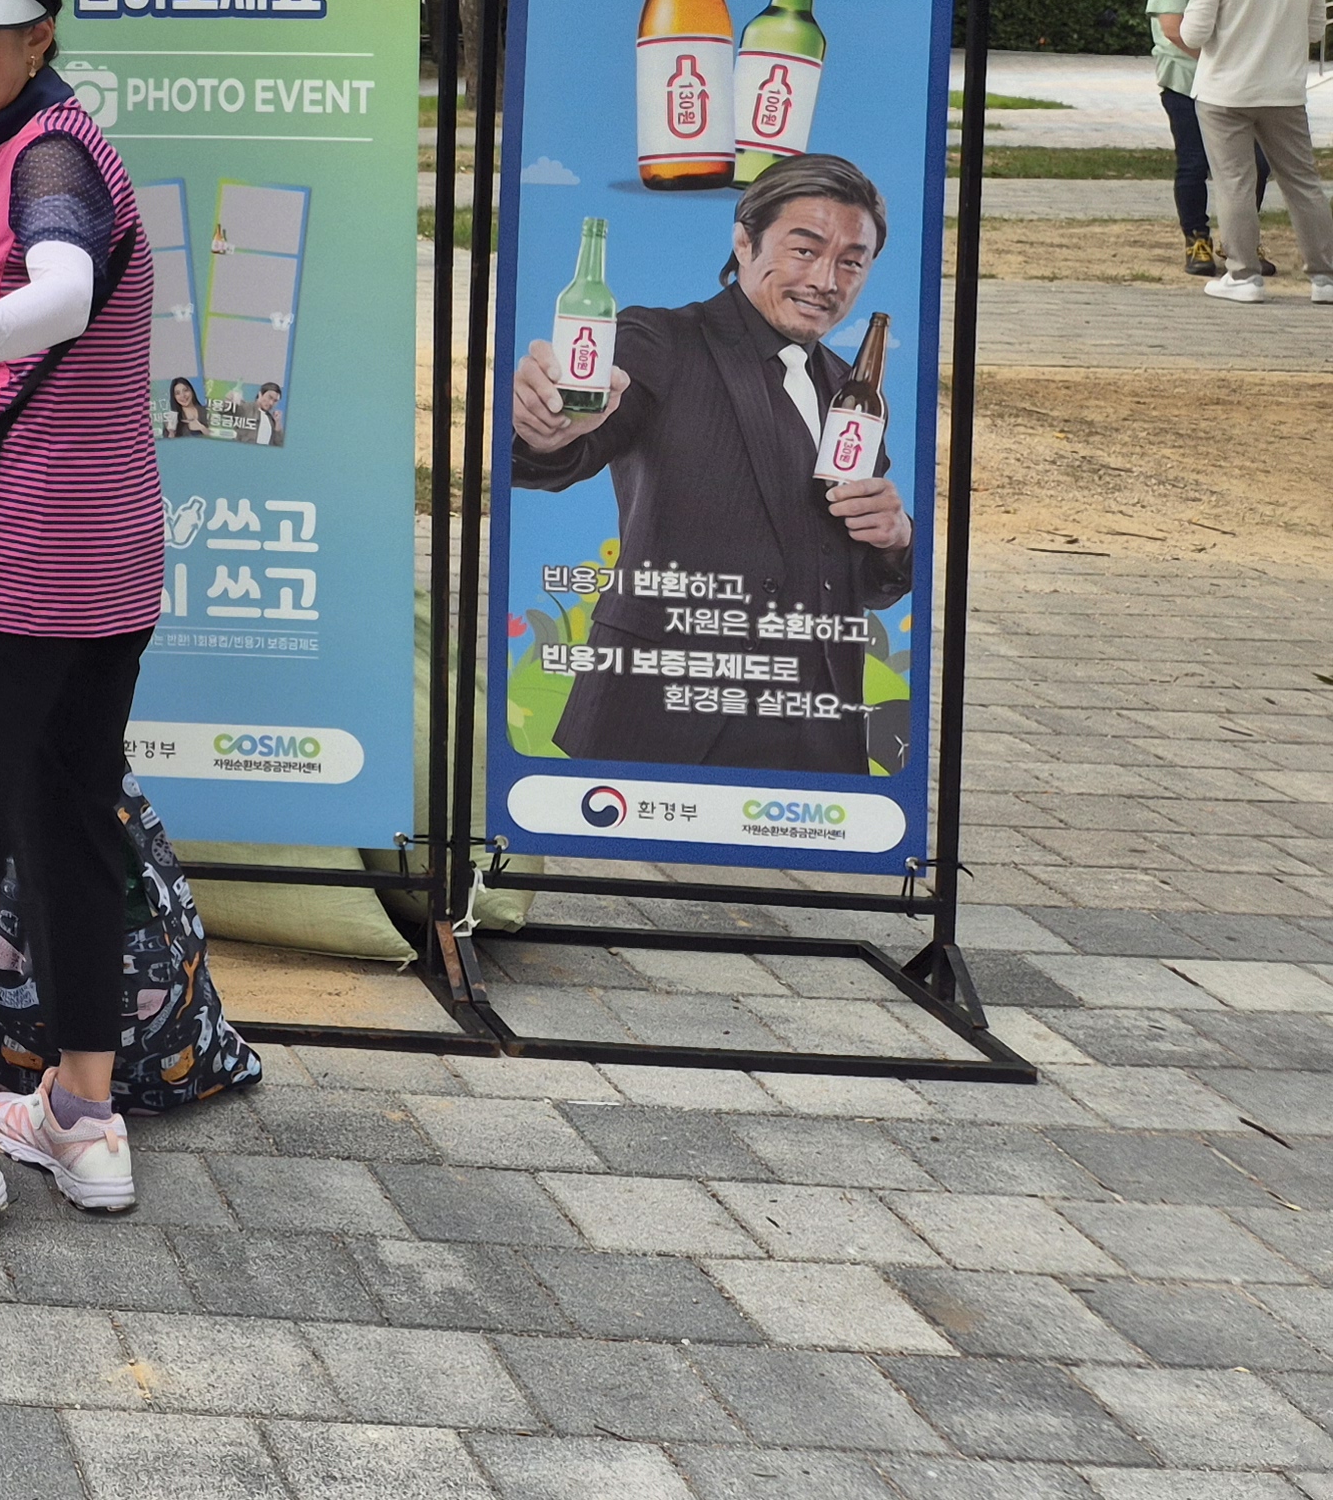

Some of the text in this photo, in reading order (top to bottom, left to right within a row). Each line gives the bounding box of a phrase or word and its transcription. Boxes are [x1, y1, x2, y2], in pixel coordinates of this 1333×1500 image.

[126, 77, 376, 115] PHOTO EVENT
[677, 81, 695, 127] 130원
[762, 86, 782, 127] 100원
[206, 412, 258, 431] 증금제도
[206, 497, 320, 553] 쓰고
[206, 564, 320, 621] 쓰고
[542, 564, 751, 604] 빈용기 반환하고,
[665, 606, 878, 646] 자원은 순환하고,
[267, 637, 319, 651] 보증금제도
[542, 644, 799, 684] 빈용기 보증금제도로
[664, 684, 749, 714] 환경을
[123, 739, 177, 759] 환경부
[213, 733, 322, 759] COSMO
[212, 757, 323, 774] 자원순환보증금관리센터
[637, 800, 698, 822] 환경부
[742, 799, 847, 825] COSMO
[741, 824, 847, 841] 자원순환보증금관리센터
